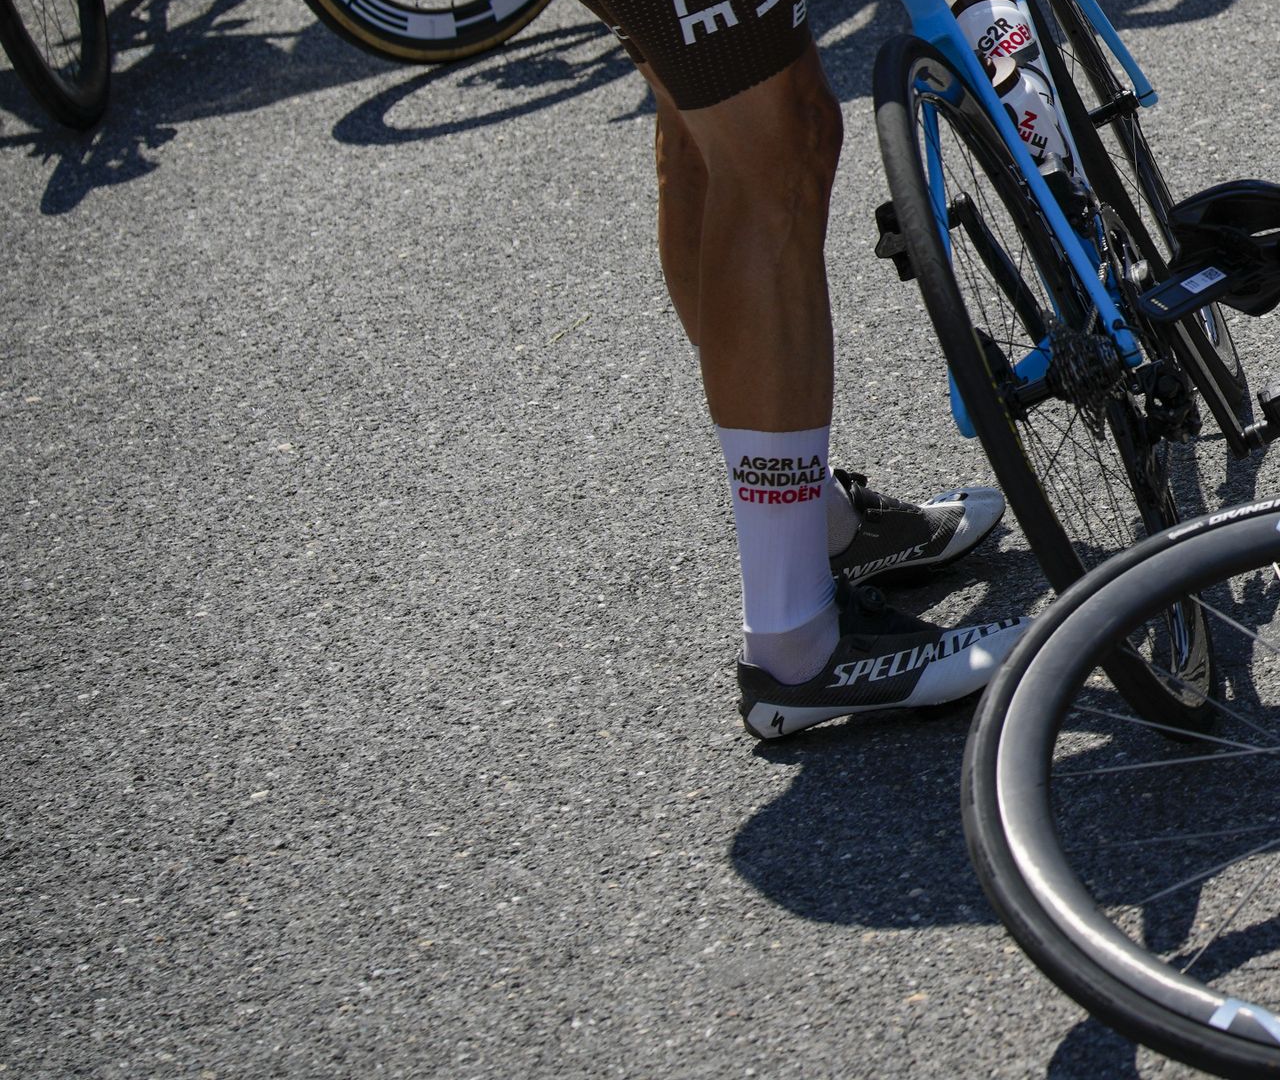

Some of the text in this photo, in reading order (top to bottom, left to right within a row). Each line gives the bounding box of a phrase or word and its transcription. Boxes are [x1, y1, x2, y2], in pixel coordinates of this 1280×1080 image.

[977, 16, 1014, 52] G2R
[739, 454, 821, 471] AG2R LA
[732, 466, 826, 488] MONDIALE
[738, 482, 822, 505] CITROËN
[825, 617, 1023, 689] SPECIALIZED
